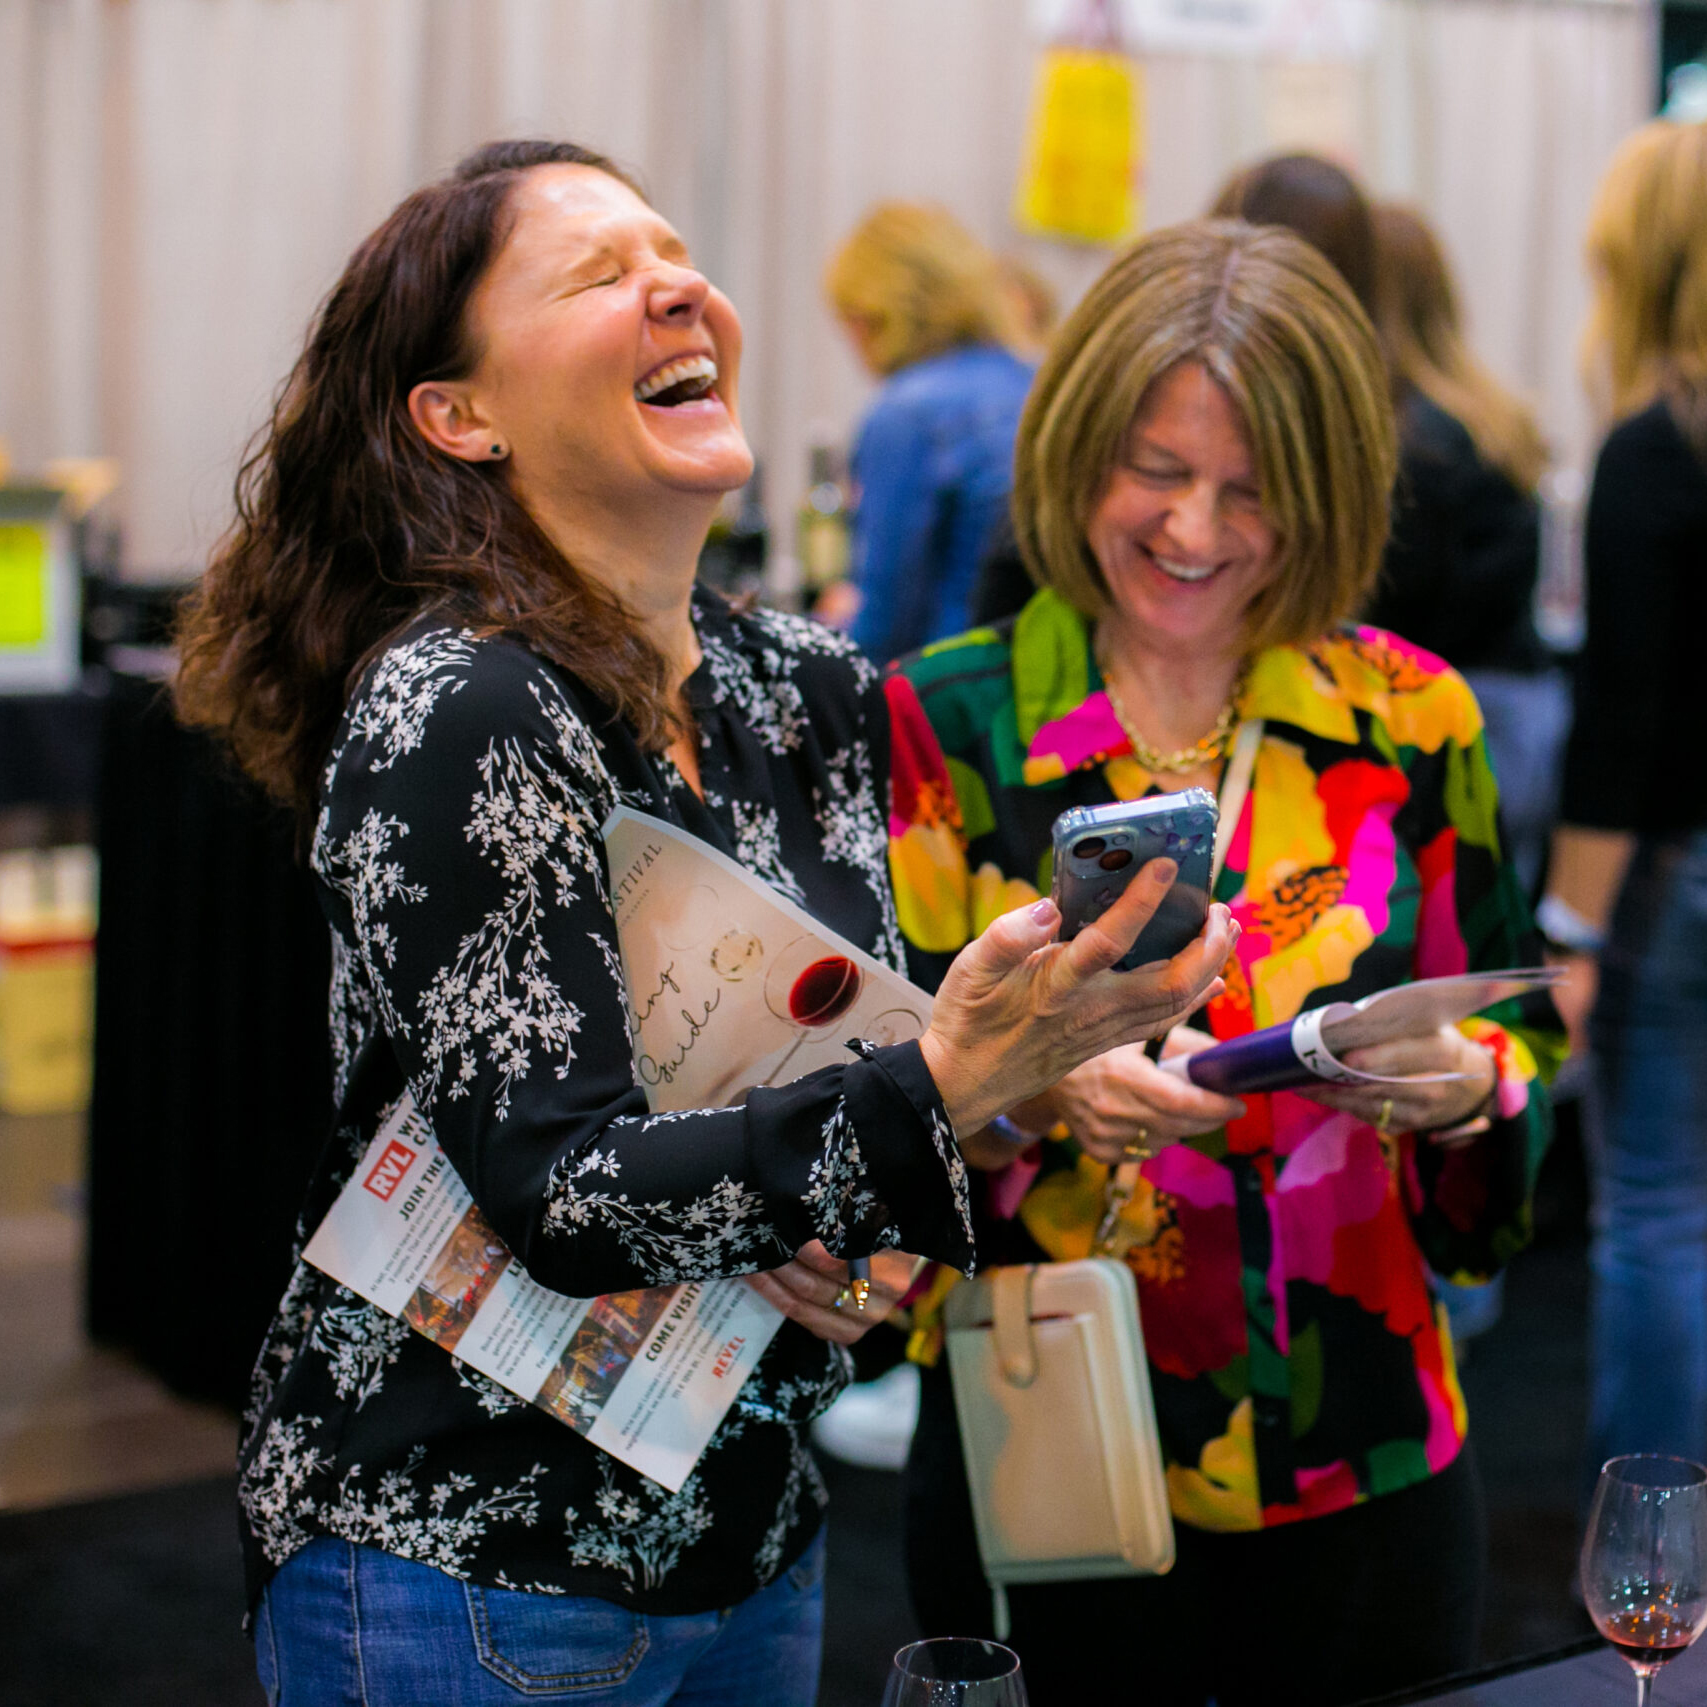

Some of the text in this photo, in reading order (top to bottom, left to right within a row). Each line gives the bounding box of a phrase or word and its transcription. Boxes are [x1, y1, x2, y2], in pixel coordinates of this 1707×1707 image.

[631, 961, 680, 1035] ing
[638, 989, 722, 1086] Guide
[367, 1142, 414, 1197] RVL
[396, 1154, 446, 1222] JOIN THE
[643, 1320, 677, 1363] COME
[708, 1331, 746, 1379] REVEL
